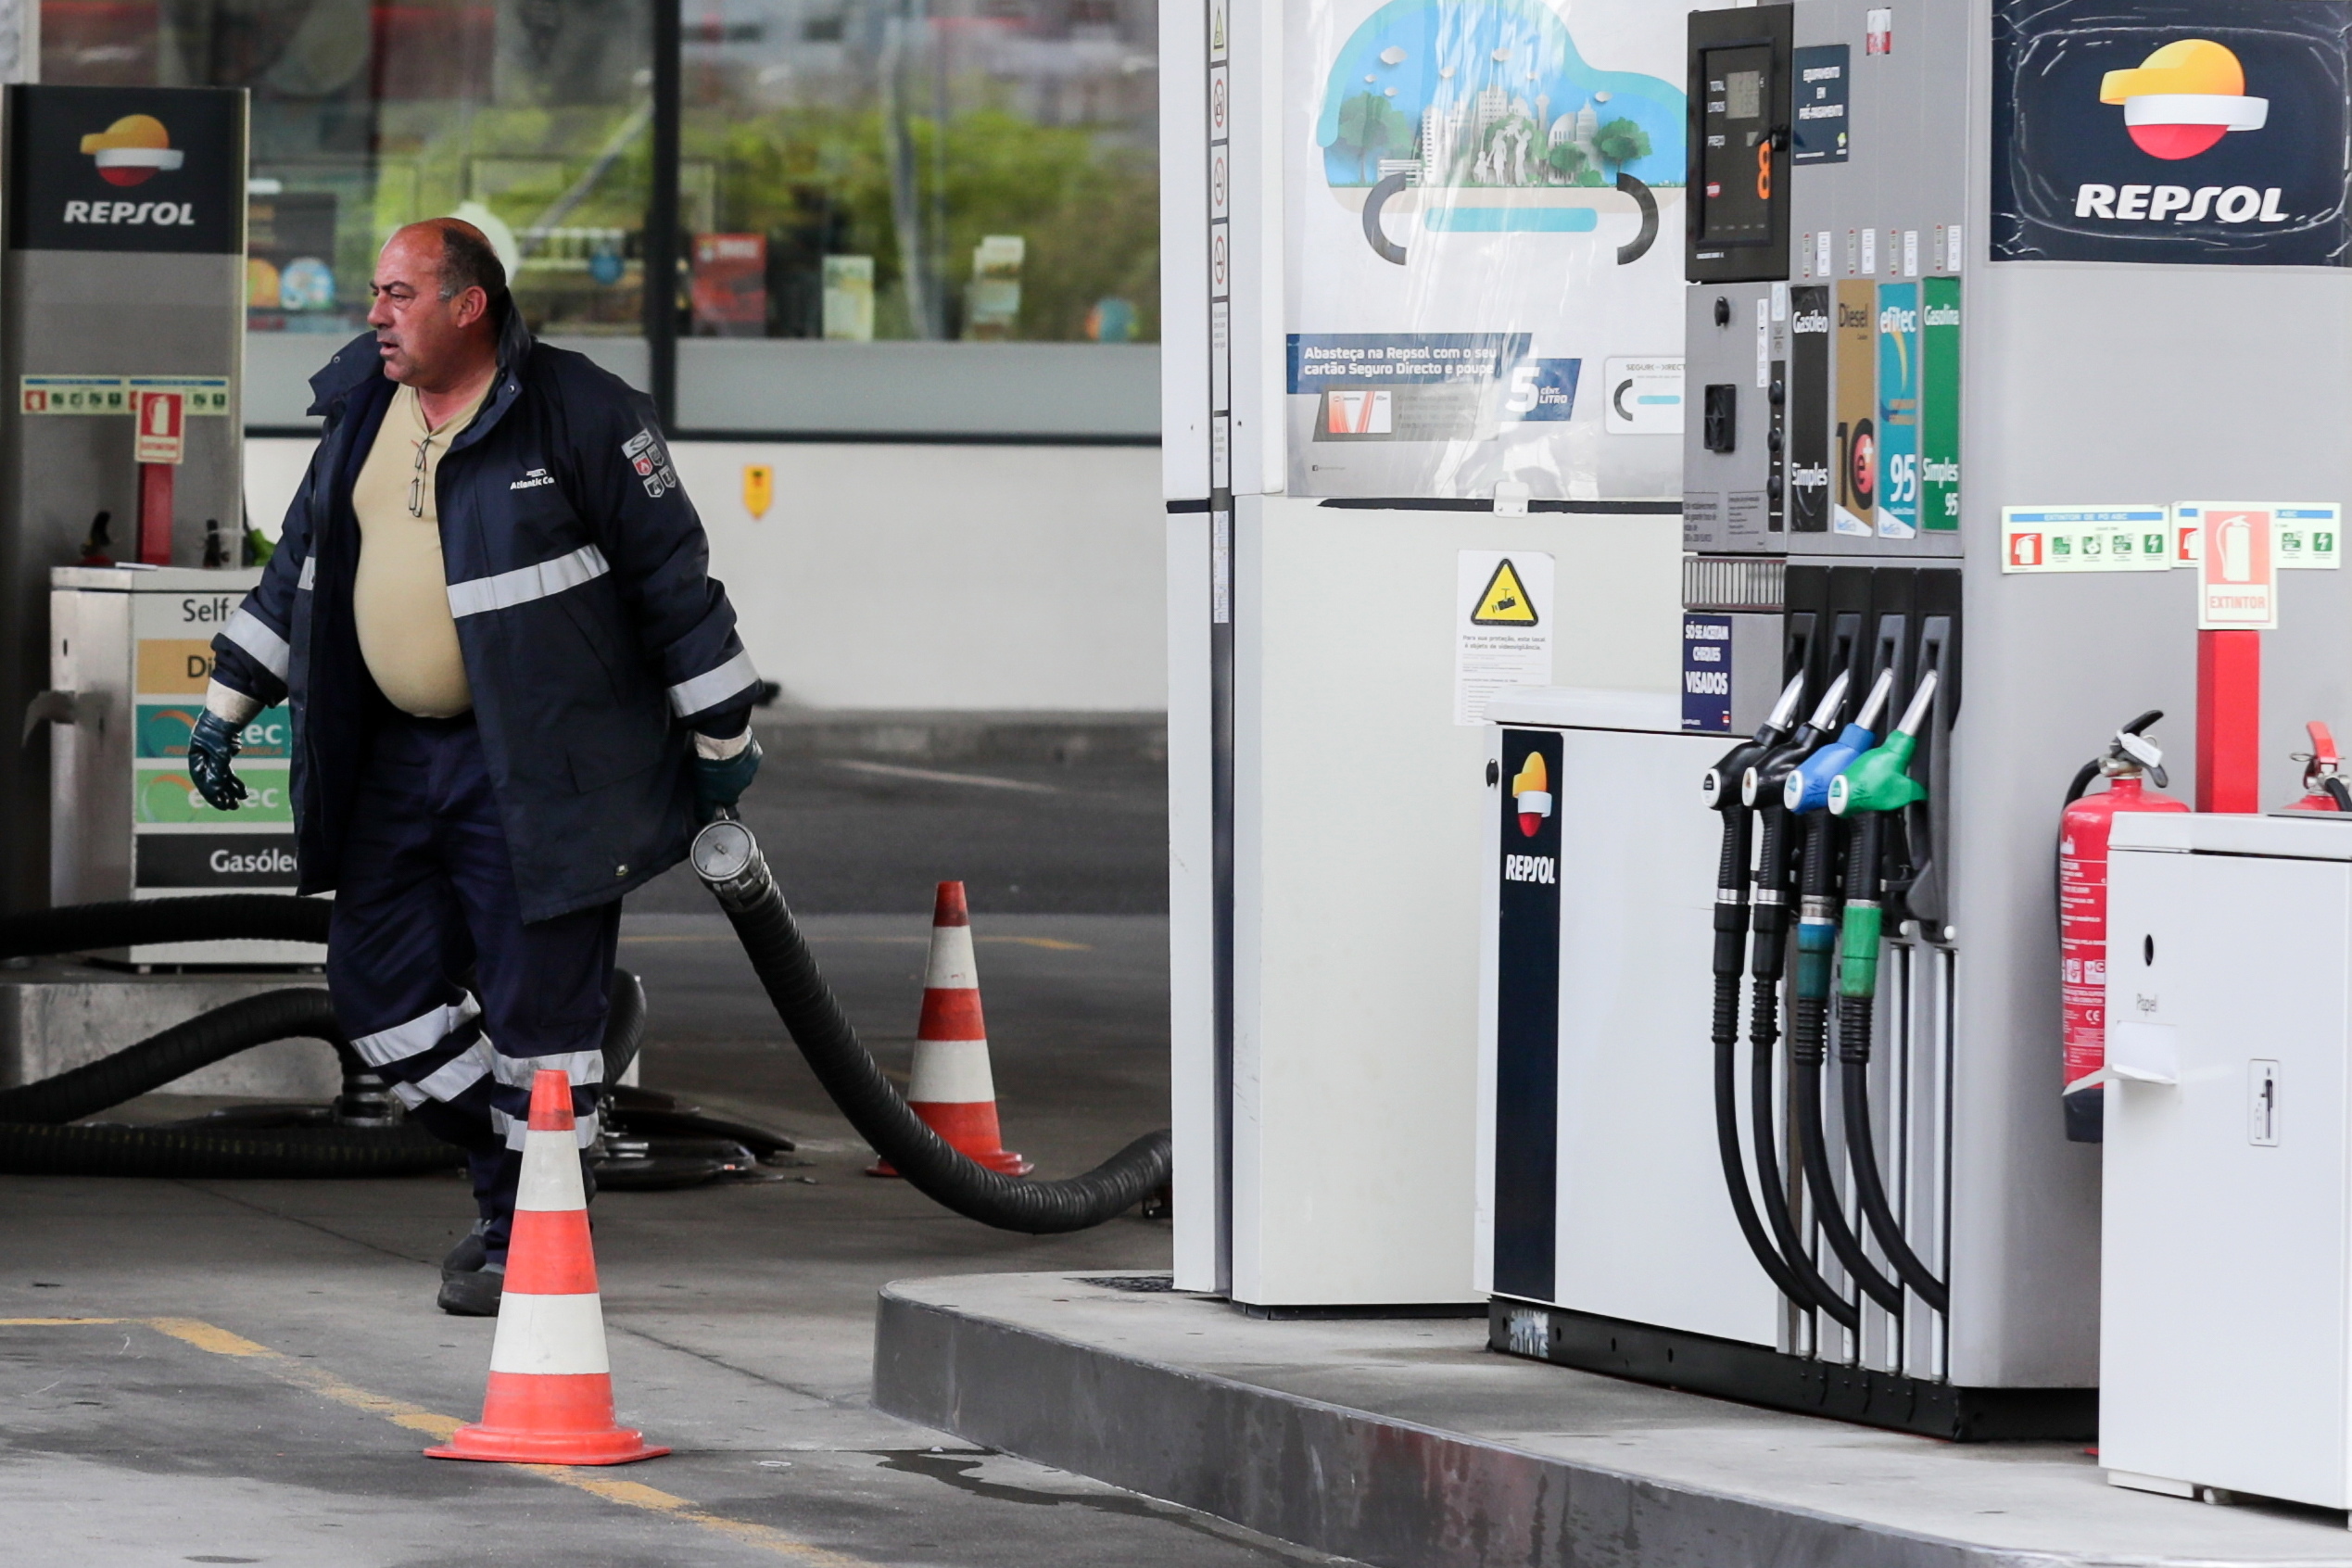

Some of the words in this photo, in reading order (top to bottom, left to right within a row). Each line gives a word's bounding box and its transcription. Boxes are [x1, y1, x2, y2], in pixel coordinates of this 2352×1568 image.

[64, 200, 195, 225] REPSOL
[2075, 183, 2287, 223] REPSOL
[1792, 310, 1827, 334] Gasóleo
[1839, 303, 1868, 327] Diesel
[1924, 304, 1960, 325] Gasolina
[1304, 347, 1365, 361] Abasteça
[1367, 349, 1384, 359] na
[1386, 346, 1430, 361] Repsol
[1433, 348, 1460, 359] com
[1462, 349, 1472, 359] o
[1474, 348, 1498, 359] seu
[1304, 361, 1346, 375] cartão
[1348, 362, 1394, 377] Seguro
[1397, 361, 1442, 375] Directo
[1444, 364, 1452, 374] e
[1456, 364, 1494, 377] poupe
[1505, 367, 1540, 412] 5
[1539, 395, 1568, 404] LITRO
[1791, 462, 1827, 493] Simples
[1890, 453, 1916, 502] 95
[1923, 457, 1958, 488] Simples
[1945, 493, 1958, 516] 95
[2209, 596, 2266, 609] EXTINTOR
[1685, 671, 1728, 695] VISADOS
[1505, 854, 1556, 884] REPSOL
[2136, 993, 2158, 1017] Papel
